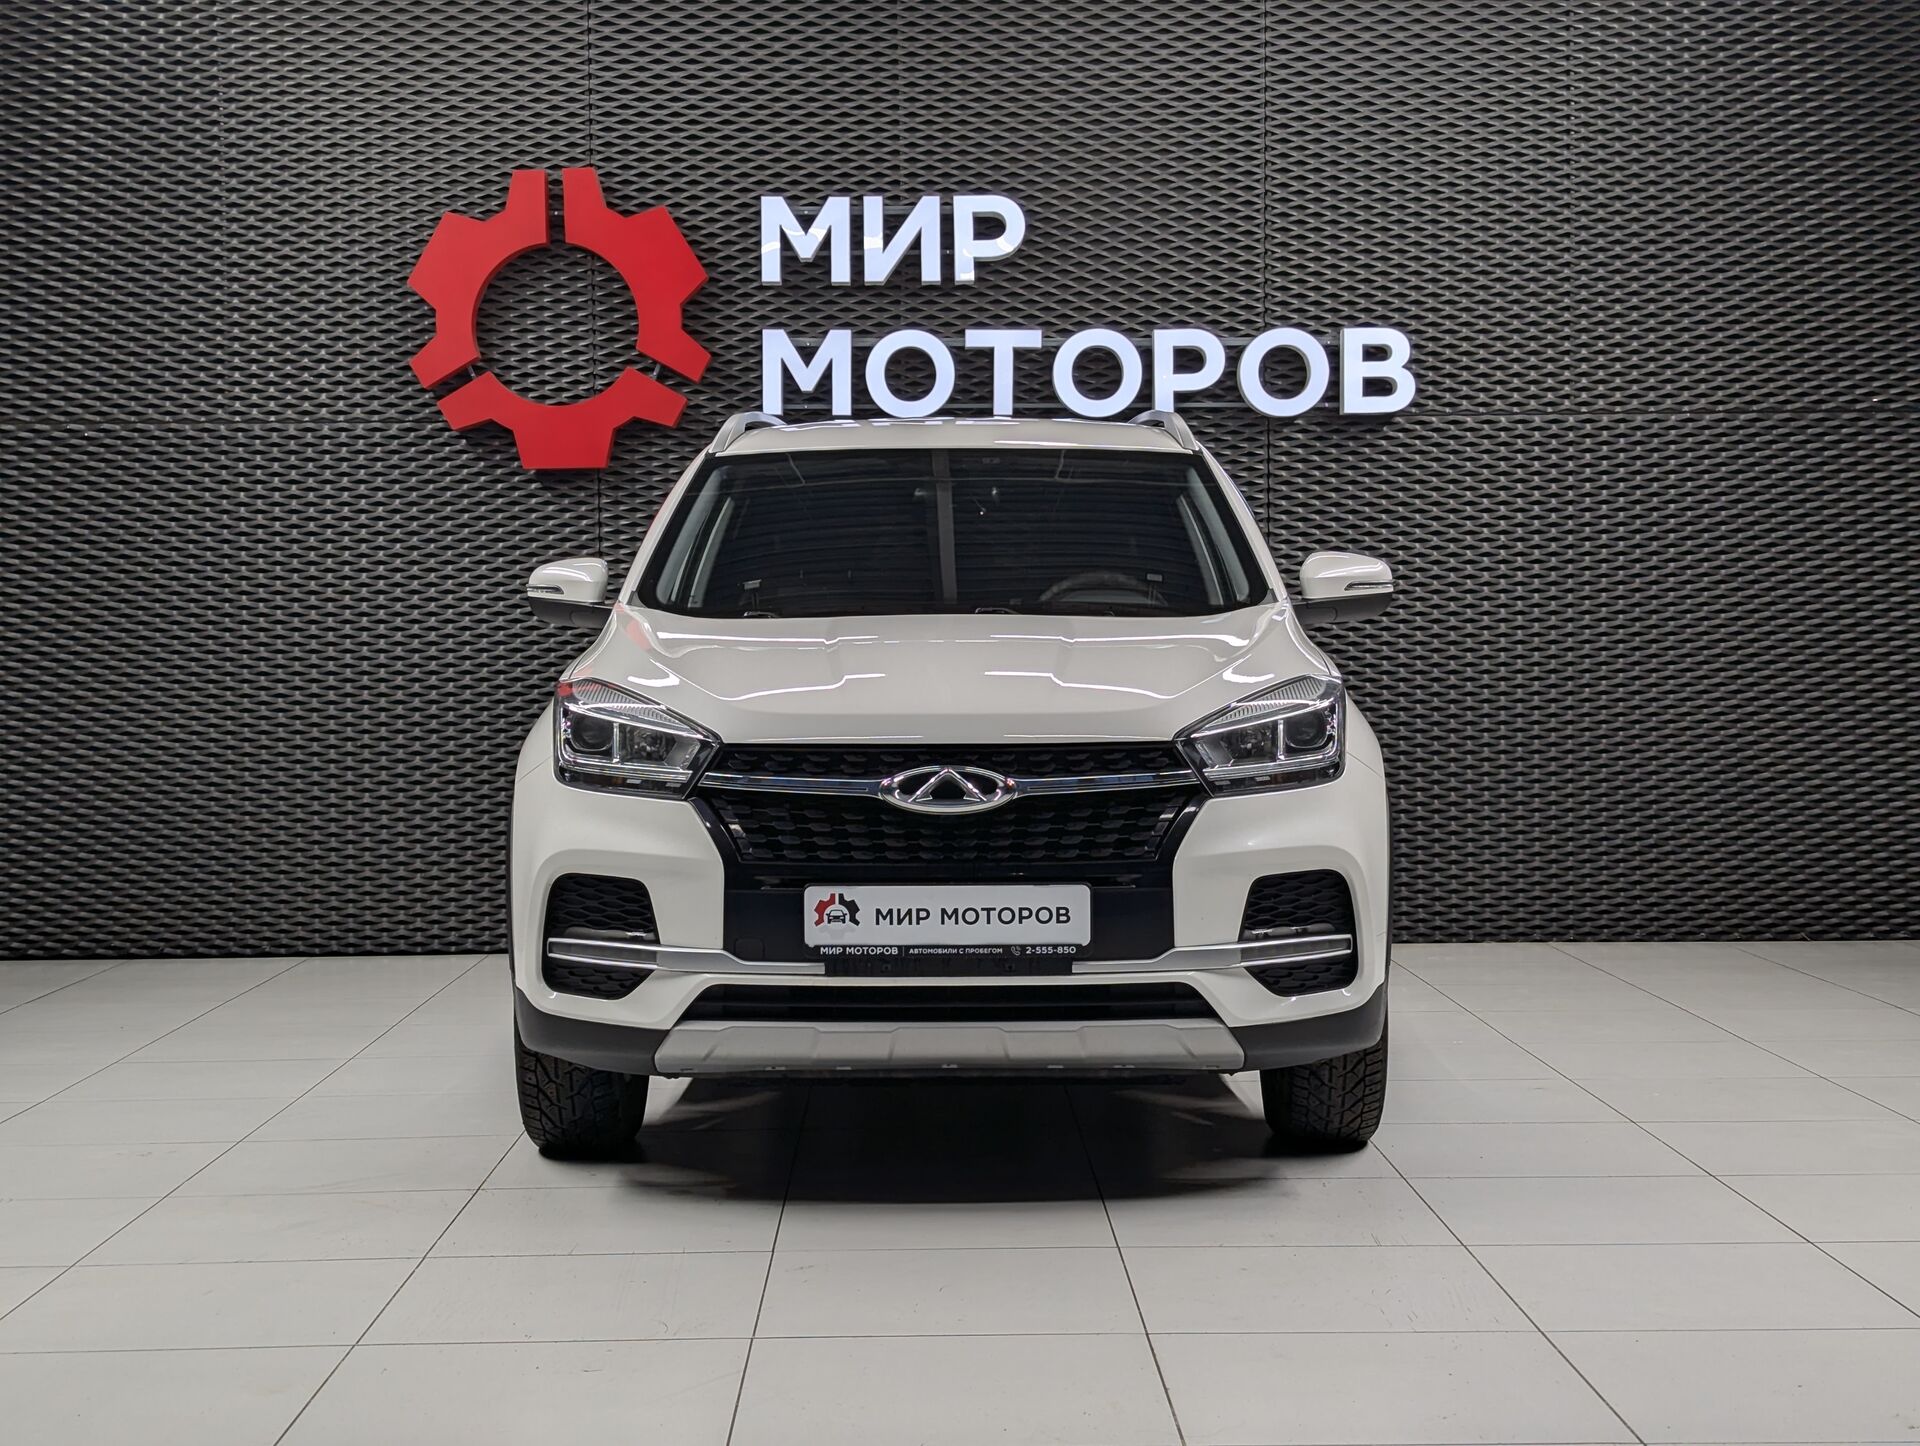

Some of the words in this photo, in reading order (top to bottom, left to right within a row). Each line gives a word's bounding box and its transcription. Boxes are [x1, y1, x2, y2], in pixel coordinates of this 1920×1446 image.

[760, 194, 1026, 286] МИР
[761, 326, 1417, 418] МОТОРОВ
[875, 908, 931, 926] МИР
[940, 906, 1072, 925] МОТОРОВ
[820, 946, 843, 955] МИР
[846, 946, 899, 955] МОТОРОВ
[1025, 946, 1077, 954] 2-555-850
